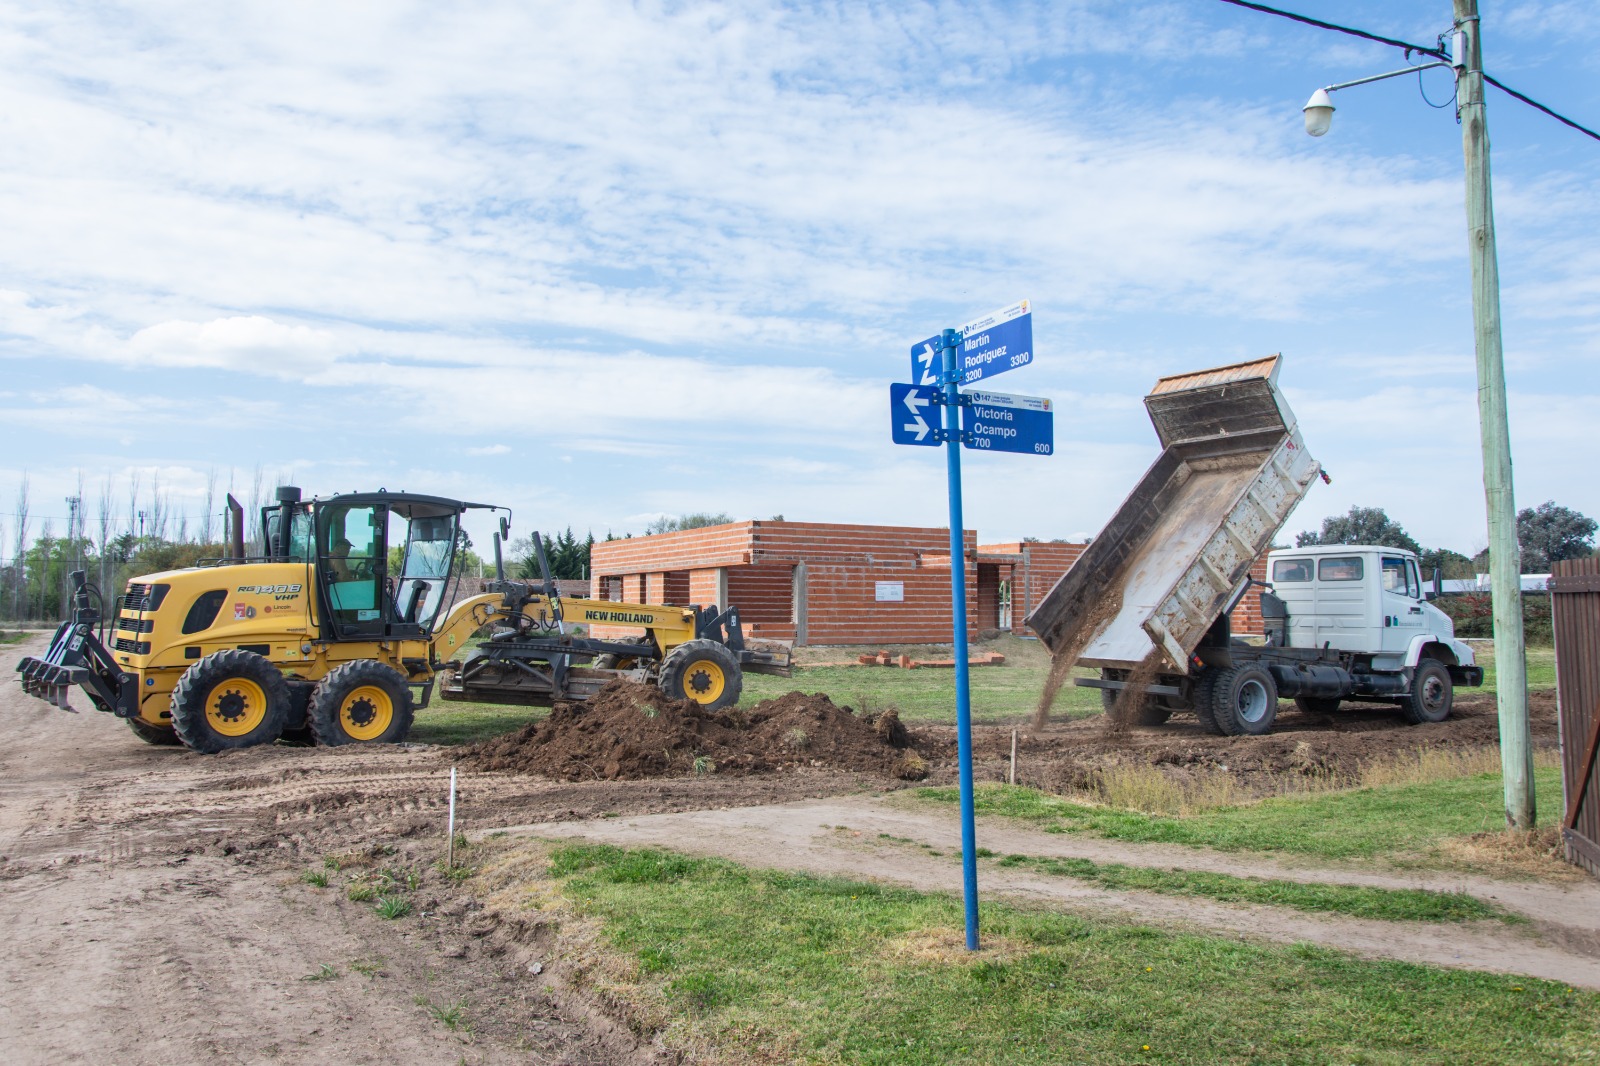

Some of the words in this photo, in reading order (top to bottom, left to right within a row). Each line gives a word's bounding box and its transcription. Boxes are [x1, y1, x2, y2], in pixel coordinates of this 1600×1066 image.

[964, 333, 990, 352] Martín
[965, 345, 1007, 368] Rodríguez
[1010, 351, 1029, 367] 3300
[965, 368, 982, 382] 3200
[974, 406, 1013, 421] Victoria
[974, 422, 1017, 439] Ocampo
[974, 437, 991, 448] 700
[1034, 442, 1050, 453] 600
[585, 610, 608, 620] NEW
[610, 612, 653, 624] HOLLAND
